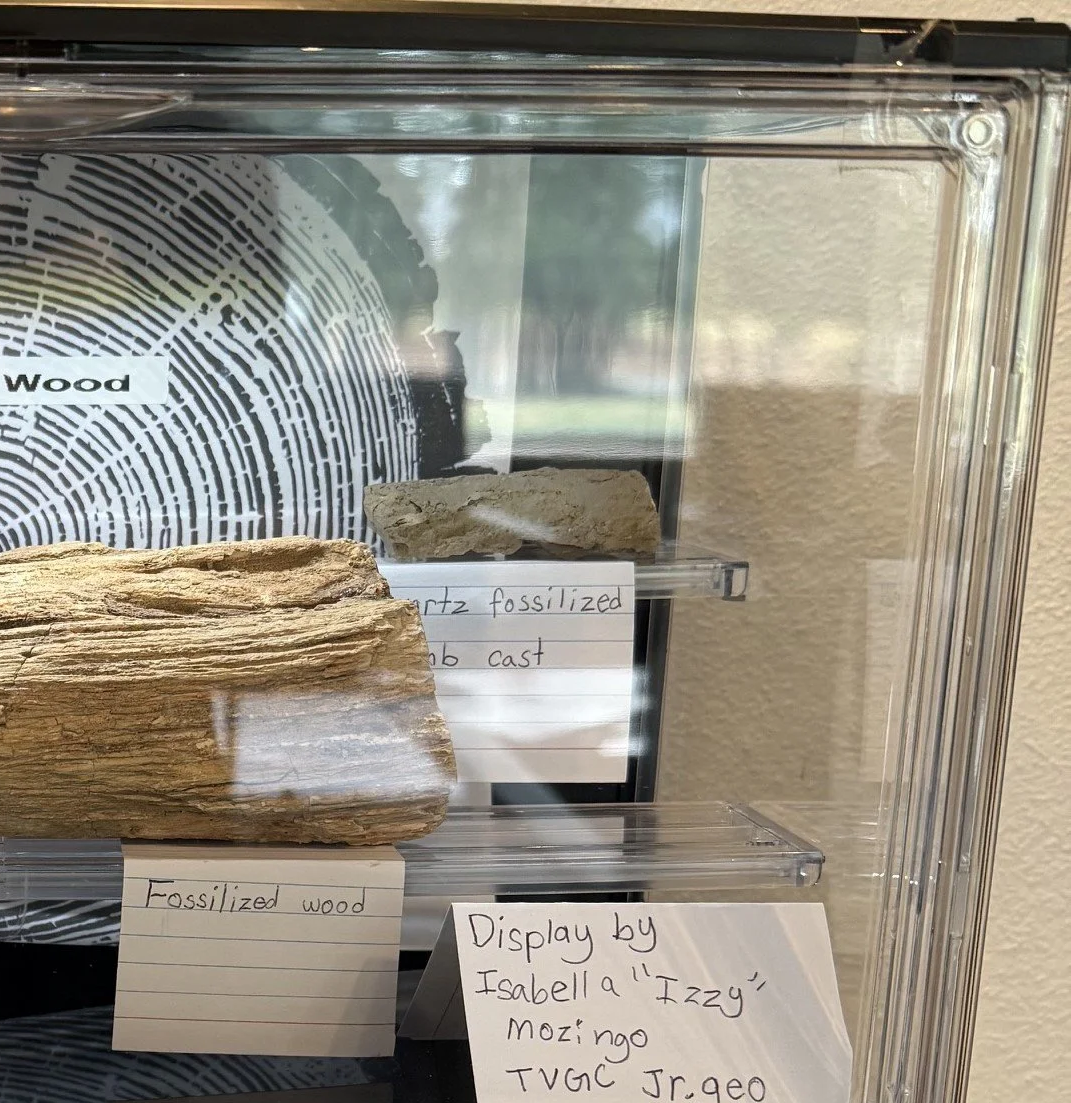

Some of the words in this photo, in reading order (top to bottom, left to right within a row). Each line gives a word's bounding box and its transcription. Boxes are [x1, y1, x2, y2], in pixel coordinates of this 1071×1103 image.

[2, 372, 131, 393] Wood
[489, 586, 622, 618] fossilized
[488, 637, 544, 668] cast
[146, 879, 280, 913] Fossilized
[302, 886, 366, 914] wood
[468, 913, 594, 964] Display
[612, 912, 657, 952] by
[475, 968, 620, 1005] Isabella
[506, 1063, 616, 1093] TVGC
